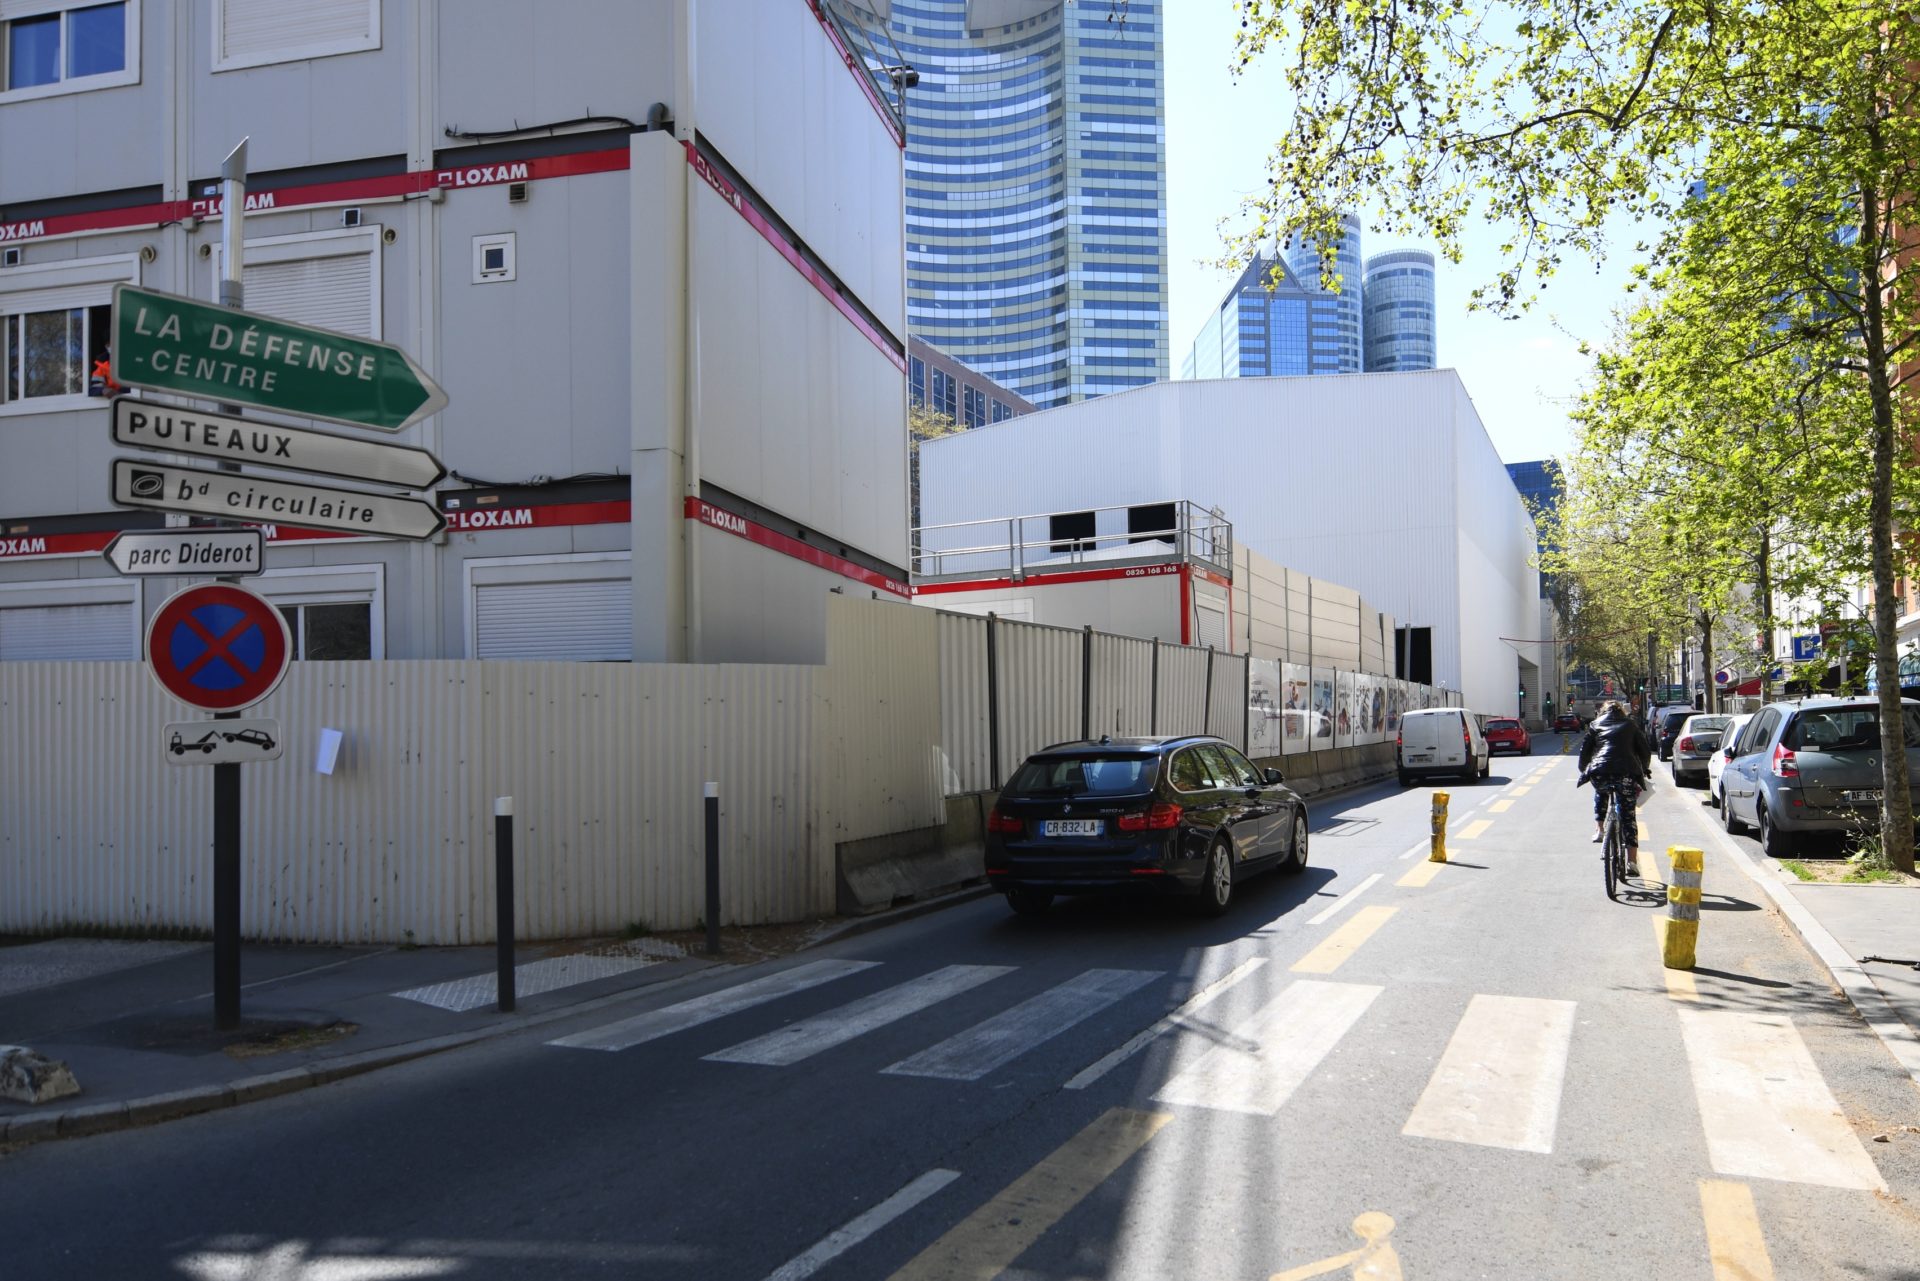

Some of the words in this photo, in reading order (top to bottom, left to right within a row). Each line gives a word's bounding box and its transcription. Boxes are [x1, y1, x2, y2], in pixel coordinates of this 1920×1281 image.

[456, 163, 528, 185] LOXAM
[209, 193, 275, 214] LAM
[135, 307, 181, 342] LA
[210, 324, 376, 381] DÉFENSE
[130, 411, 291, 458] PUTEAUX
[227, 487, 374, 523] circulaire
[460, 508, 532, 528] LOXAM
[711, 508, 746, 534] LOXAM
[128, 548, 171, 570] parc
[178, 542, 253, 564] Diderot
[1125, 568, 1145, 576] 0826
[1163, 565, 1177, 573] 168
[1801, 640, 1813, 655] P
